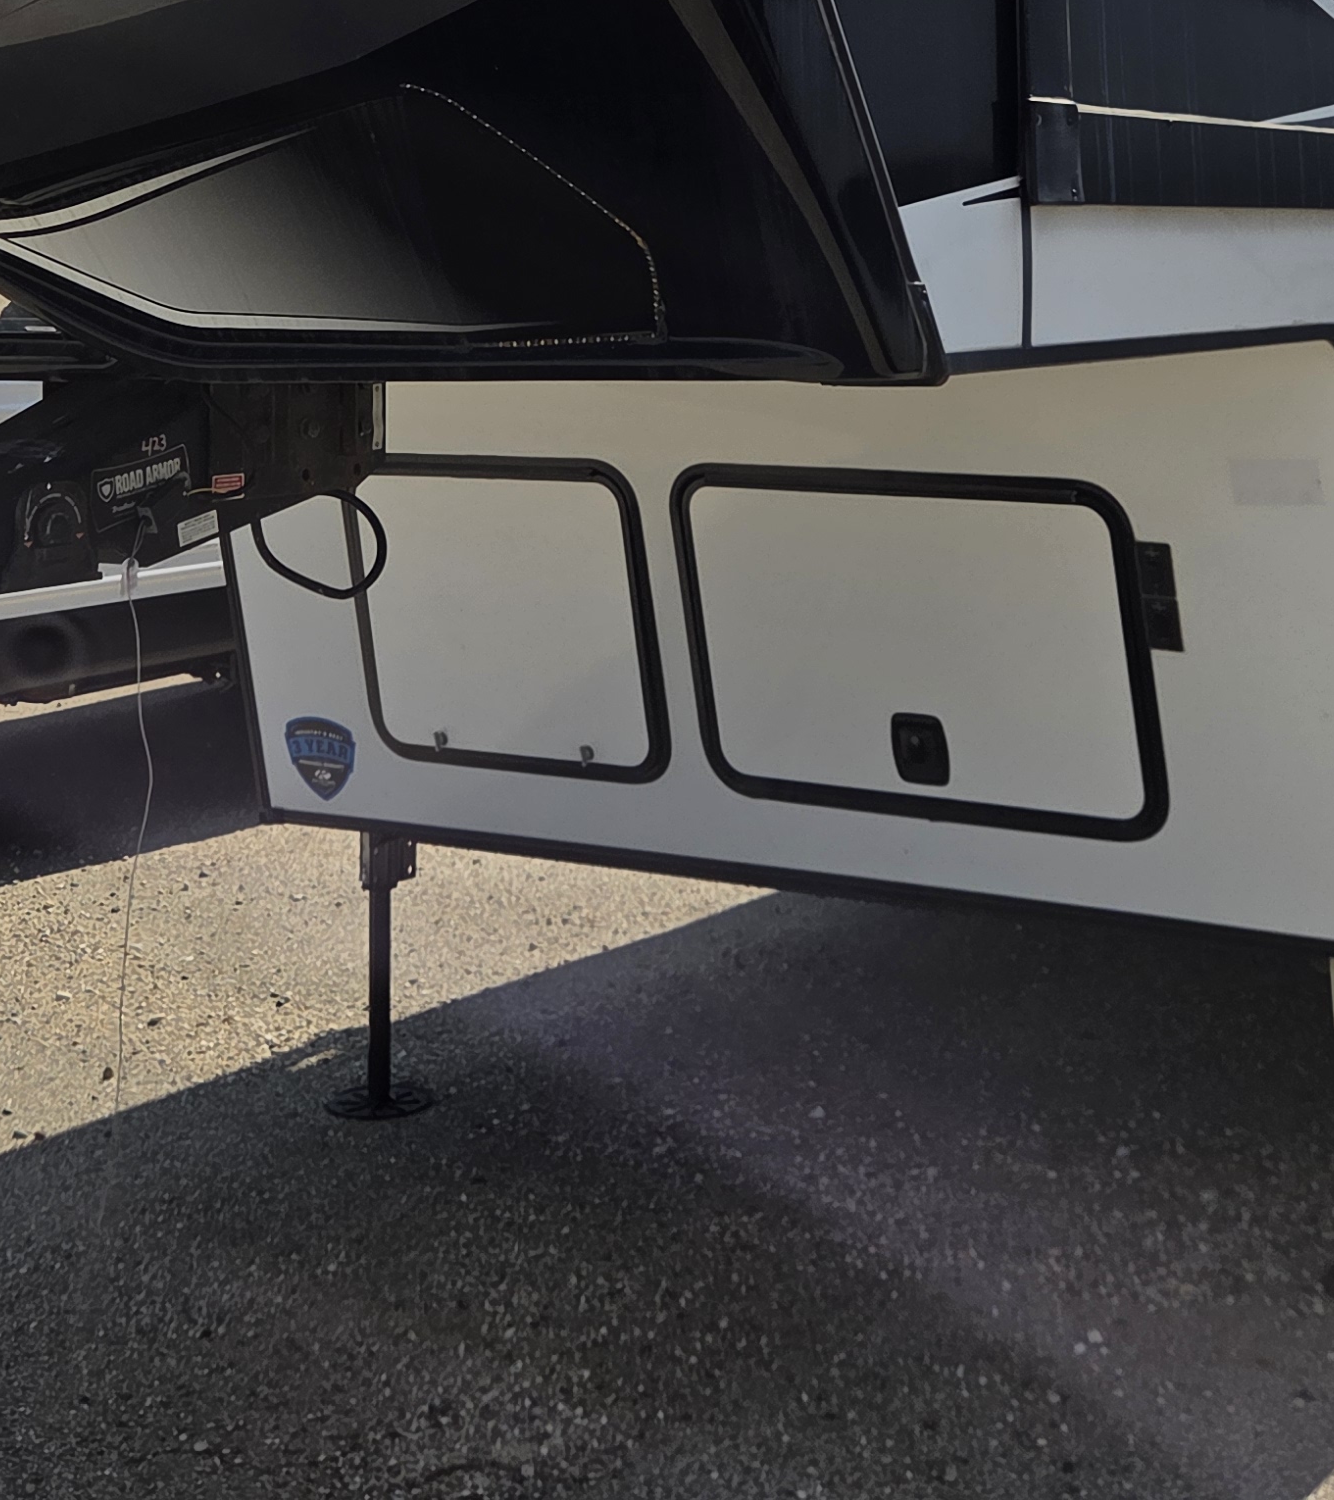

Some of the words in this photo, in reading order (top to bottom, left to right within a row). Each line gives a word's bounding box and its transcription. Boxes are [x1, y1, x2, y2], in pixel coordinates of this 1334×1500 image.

[141, 434, 167, 457] 423
[115, 468, 144, 495] ROAD
[145, 457, 182, 483] ARMOR
[305, 739, 348, 760] YEAR
